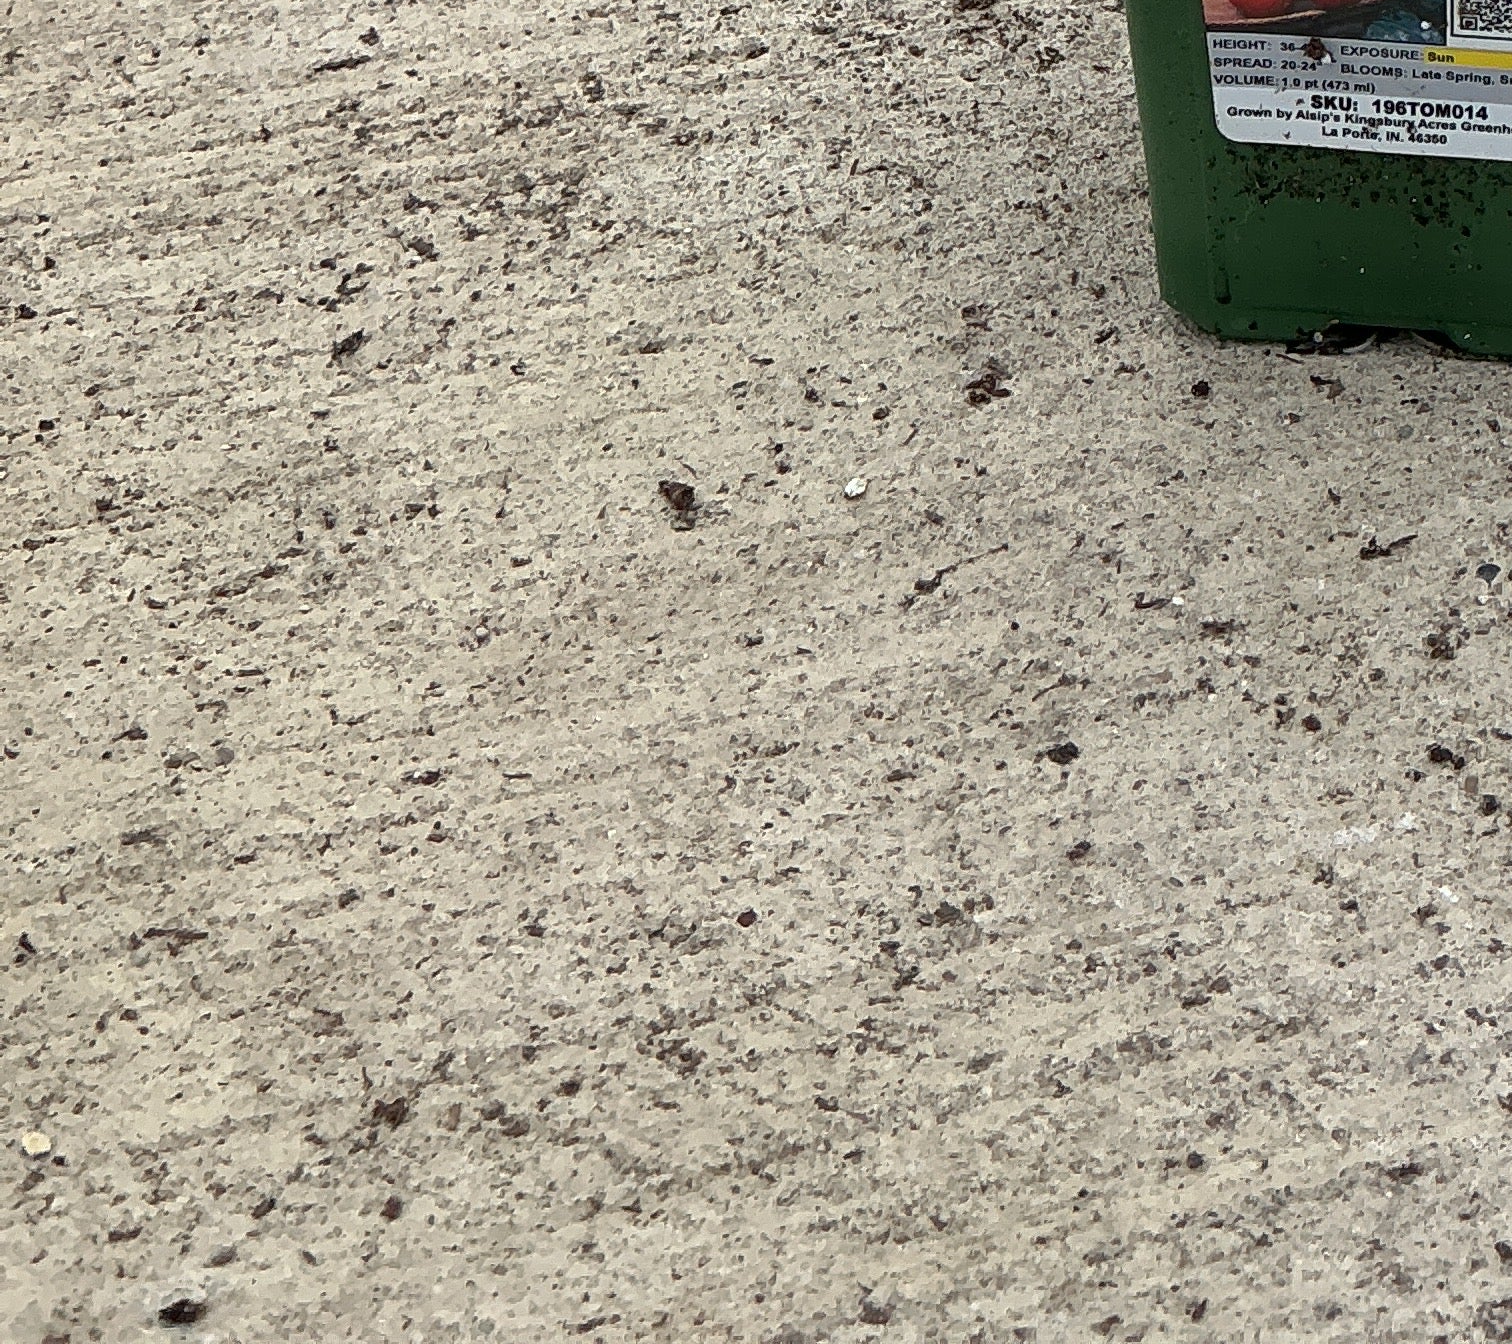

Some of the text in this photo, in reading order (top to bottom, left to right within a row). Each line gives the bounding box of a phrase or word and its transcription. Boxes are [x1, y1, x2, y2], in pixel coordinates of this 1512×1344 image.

[1212, 39, 1273, 51] HEIGHT:
[1340, 45, 1455, 63] EXPOSURE: Sun
[1213, 57, 1277, 69] SPREAD:
[1213, 74, 1376, 95] VOLUME: 1.0 pt (473 ml)
[1340, 63, 1408, 80] BLOOMS:
[1412, 70, 1442, 81] Late
[1445, 71, 1496, 86] Spring,
[1310, 95, 1489, 121] SKU: 196TOM014
[1226, 106, 1273, 119] Grown
[1276, 108, 1292, 121] by
[1295, 109, 1341, 123] Alsip's
[1344, 113, 1415, 132] Kingsbury
[1418, 118, 1457, 131] Acres
[1321, 125, 1339, 137] La
[1407, 132, 1448, 145] 46350
